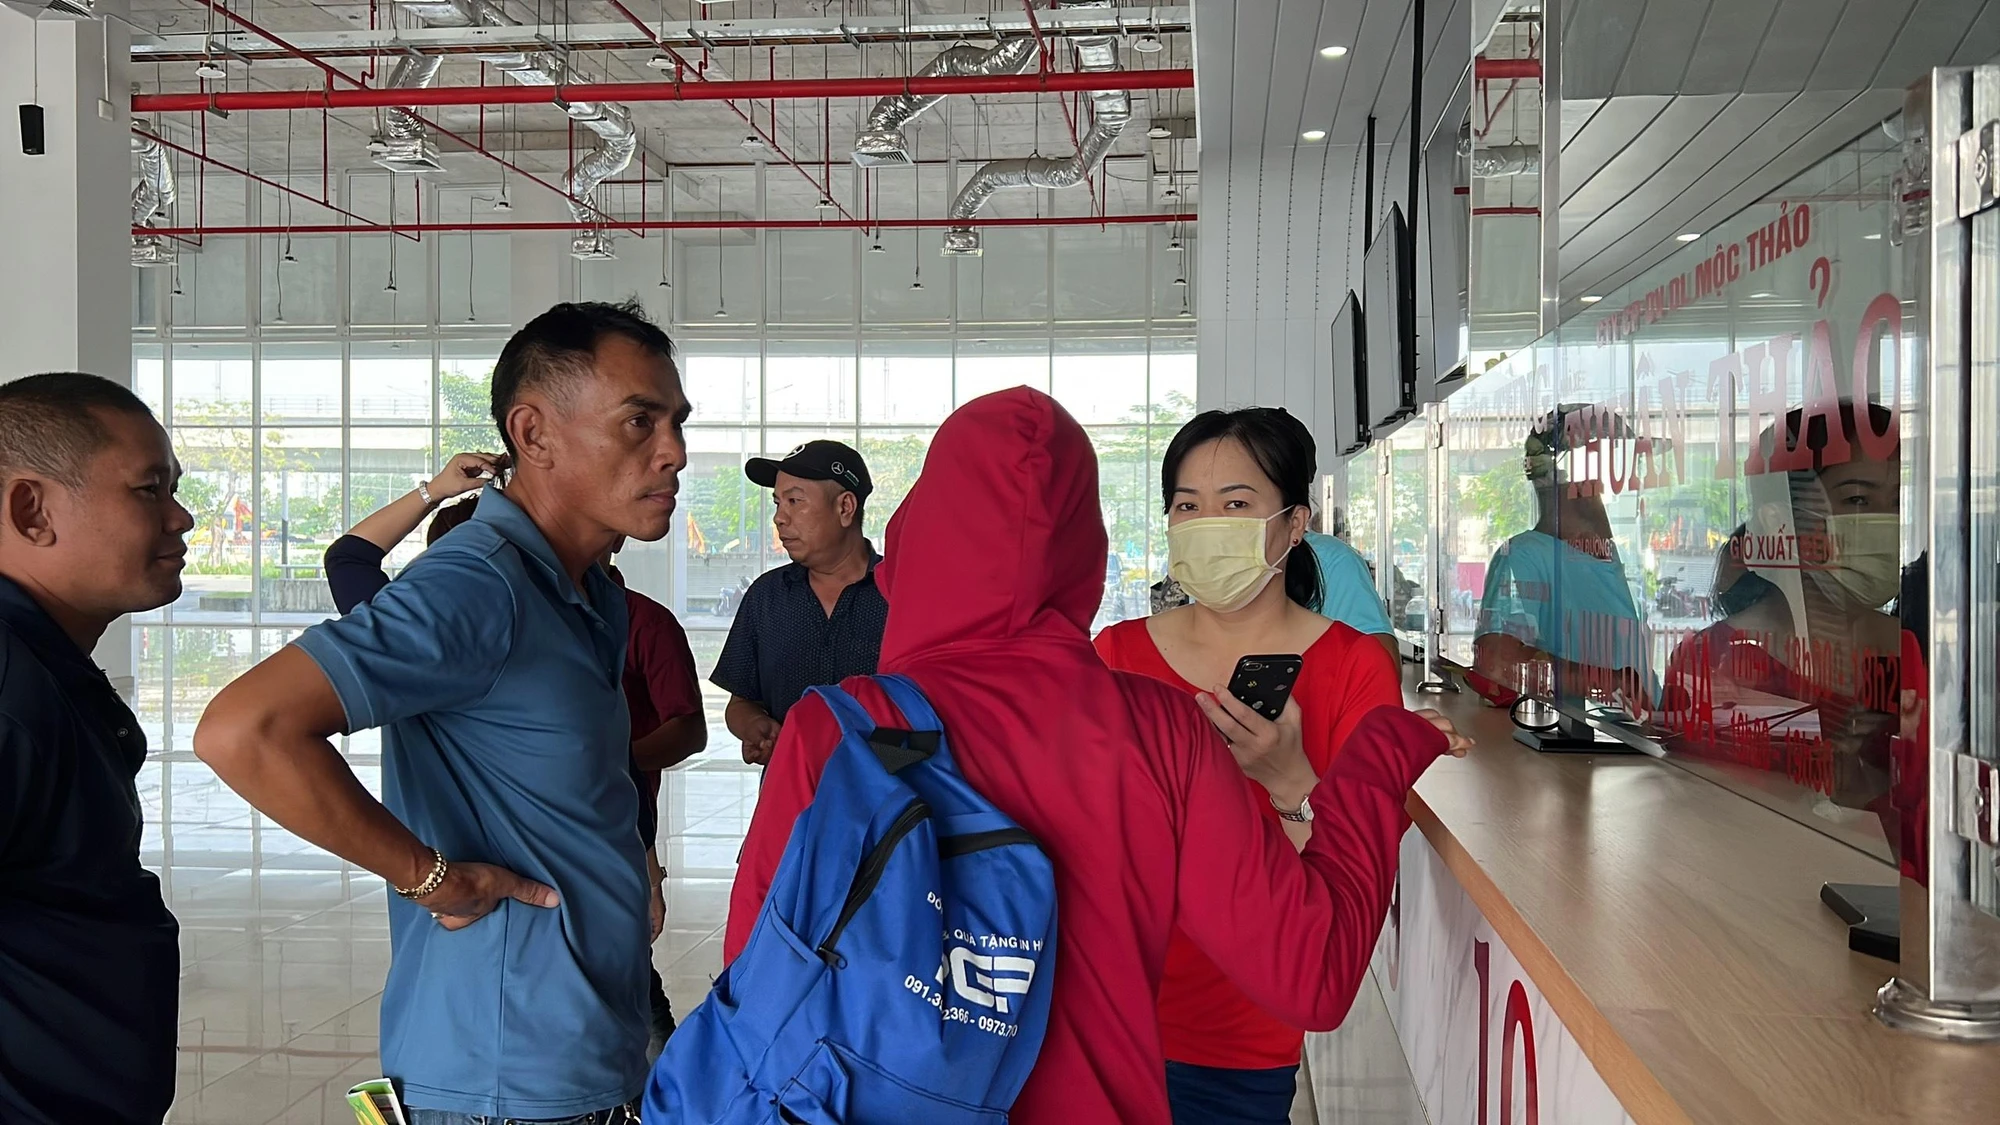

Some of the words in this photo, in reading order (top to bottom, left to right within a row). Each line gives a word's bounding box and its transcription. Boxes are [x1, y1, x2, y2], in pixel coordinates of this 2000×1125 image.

[1695, 243, 1740, 297] MỘC
[1746, 201, 1810, 272] THẢO
[1564, 351, 1693, 518] THUẬN
[1706, 256, 1901, 475] THẢO
[1730, 528, 1753, 560] GIỜ
[1757, 523, 1795, 561] XUẤT
[1852, 647, 1899, 714] 18h2
[980, 934, 1017, 950] TẶNG
